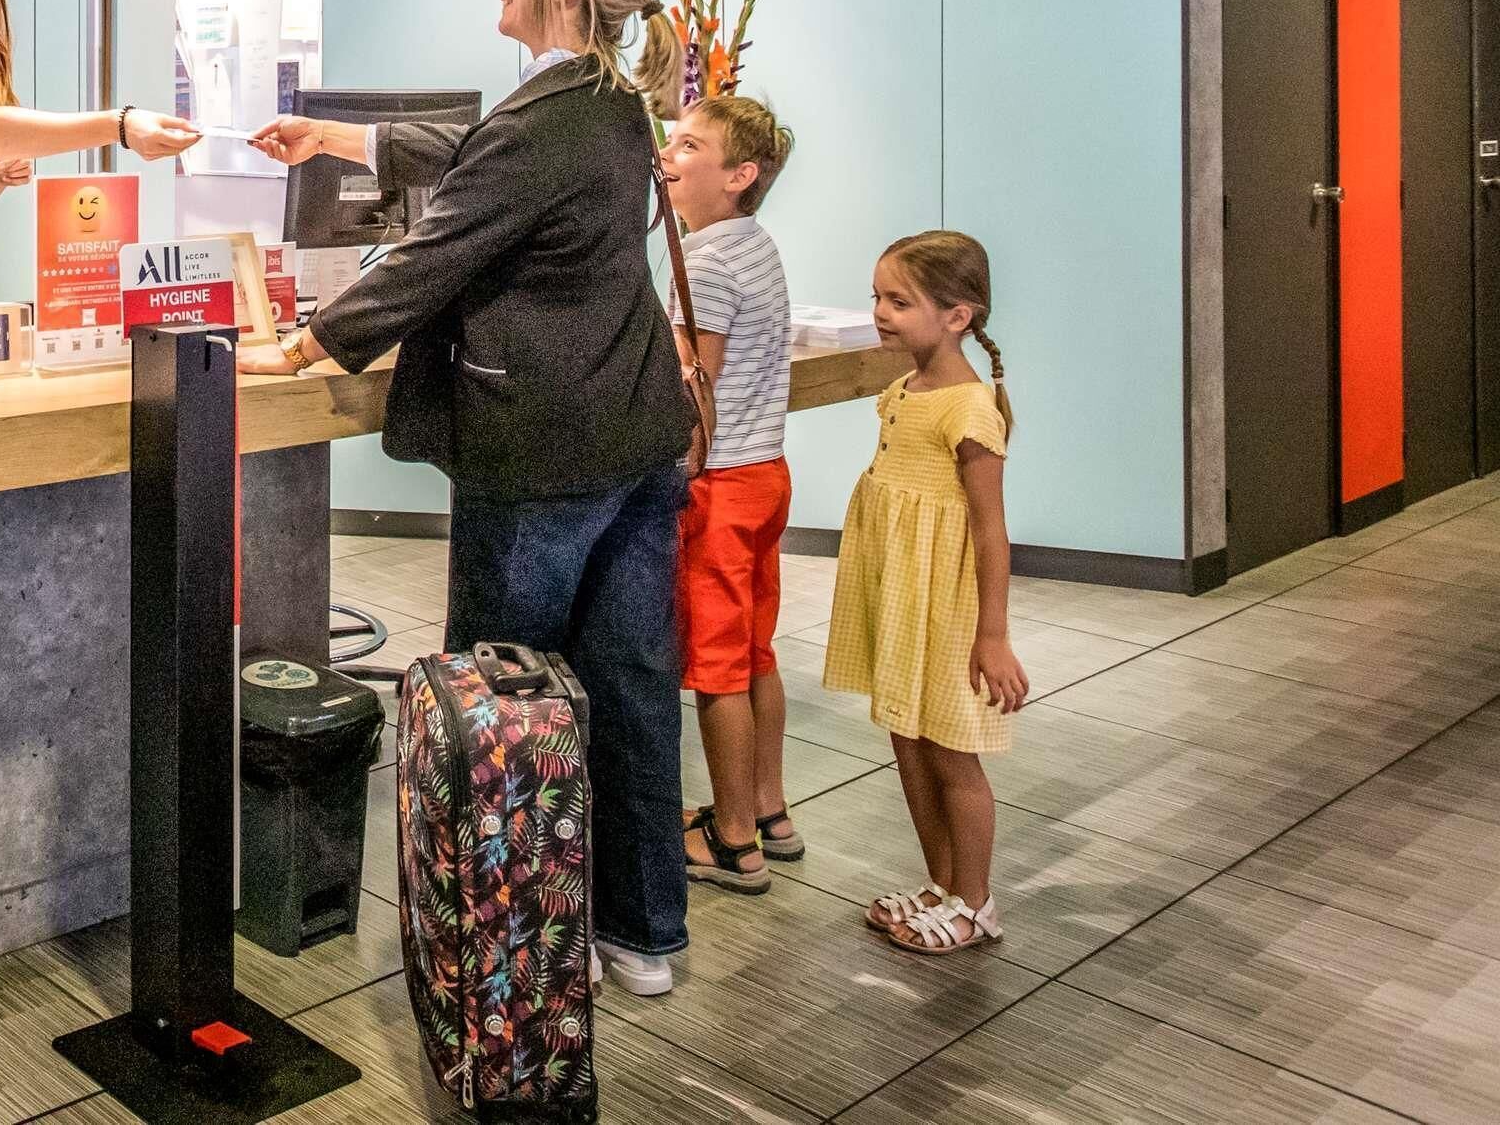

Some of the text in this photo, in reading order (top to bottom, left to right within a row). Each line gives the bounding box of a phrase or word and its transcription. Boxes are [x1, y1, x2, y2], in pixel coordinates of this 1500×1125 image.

[57, 239, 120, 255] SATISFAIT
[184, 272, 221, 281] LIMITLESS
[149, 288, 212, 307] HYGIENE
[162, 309, 205, 322] POINT
